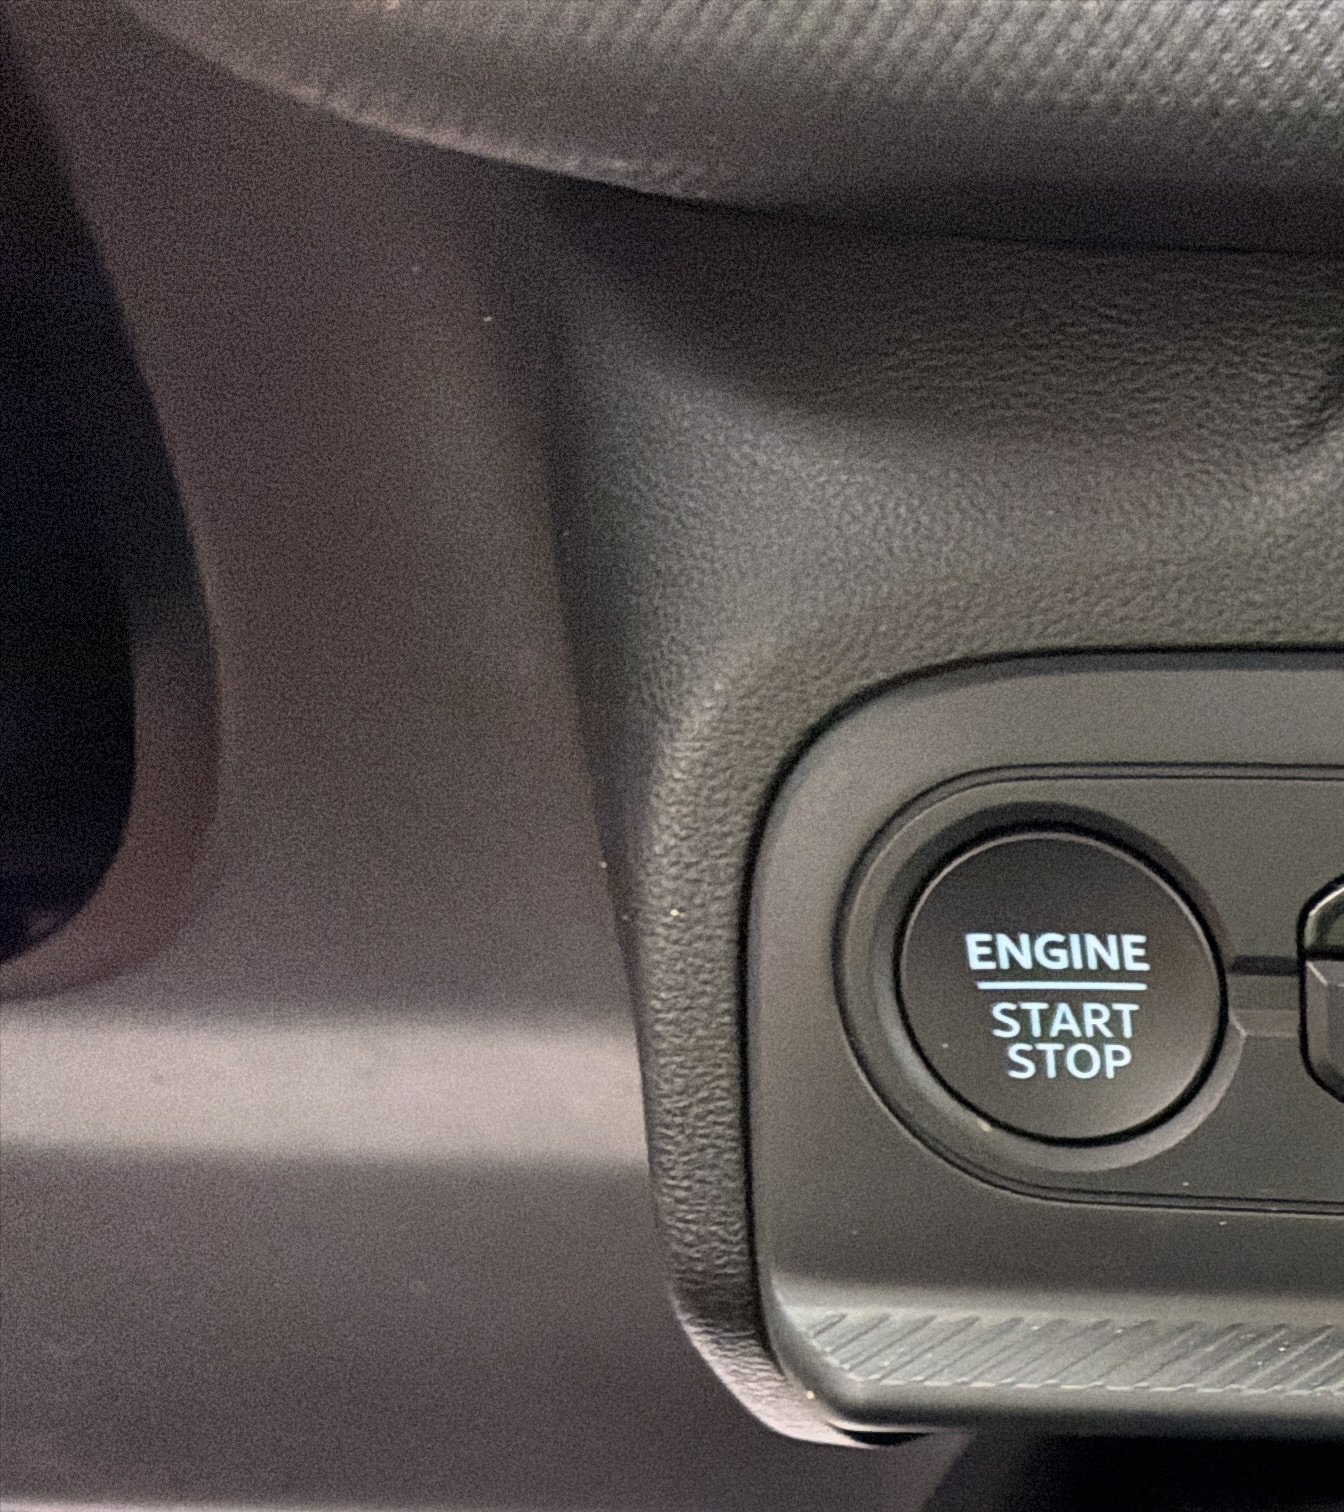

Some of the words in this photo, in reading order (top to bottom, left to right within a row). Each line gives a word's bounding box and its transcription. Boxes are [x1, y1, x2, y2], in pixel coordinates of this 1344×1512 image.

[964, 932, 1151, 971] ENGINE
[991, 1001, 1140, 1039] START
[1006, 1042, 1133, 1080] STOP
